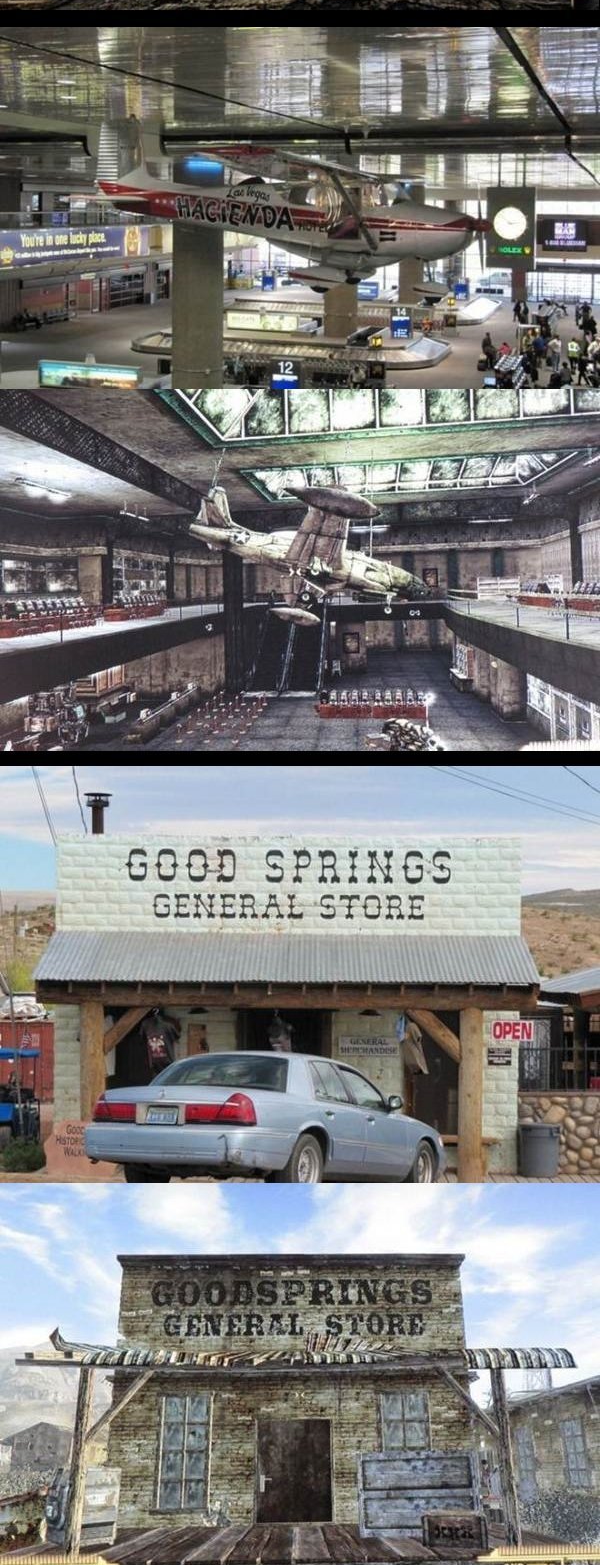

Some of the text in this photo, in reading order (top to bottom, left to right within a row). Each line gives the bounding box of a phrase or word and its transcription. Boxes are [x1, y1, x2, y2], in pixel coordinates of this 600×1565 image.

[227, 186, 271, 202] Las Vegas
[21, 234, 44, 248] You're
[46, 234, 53, 245] in
[55, 234, 68, 245] one
[70, 232, 87, 246] lucky
[396, 307, 406, 316] 14
[278, 361, 293, 375] 12
[126, 848, 451, 885] GOOD SPRINGS
[153, 893, 425, 920] GENERAL STORE
[493, 1022, 532, 1039] OPEN
[340, 1046, 398, 1054] MERCHANDISE
[350, 1038, 388, 1046] GENERAL
[151, 1278, 433, 1307] GOODSPRINGS
[164, 1312, 424, 1336] GENERAL STORE
